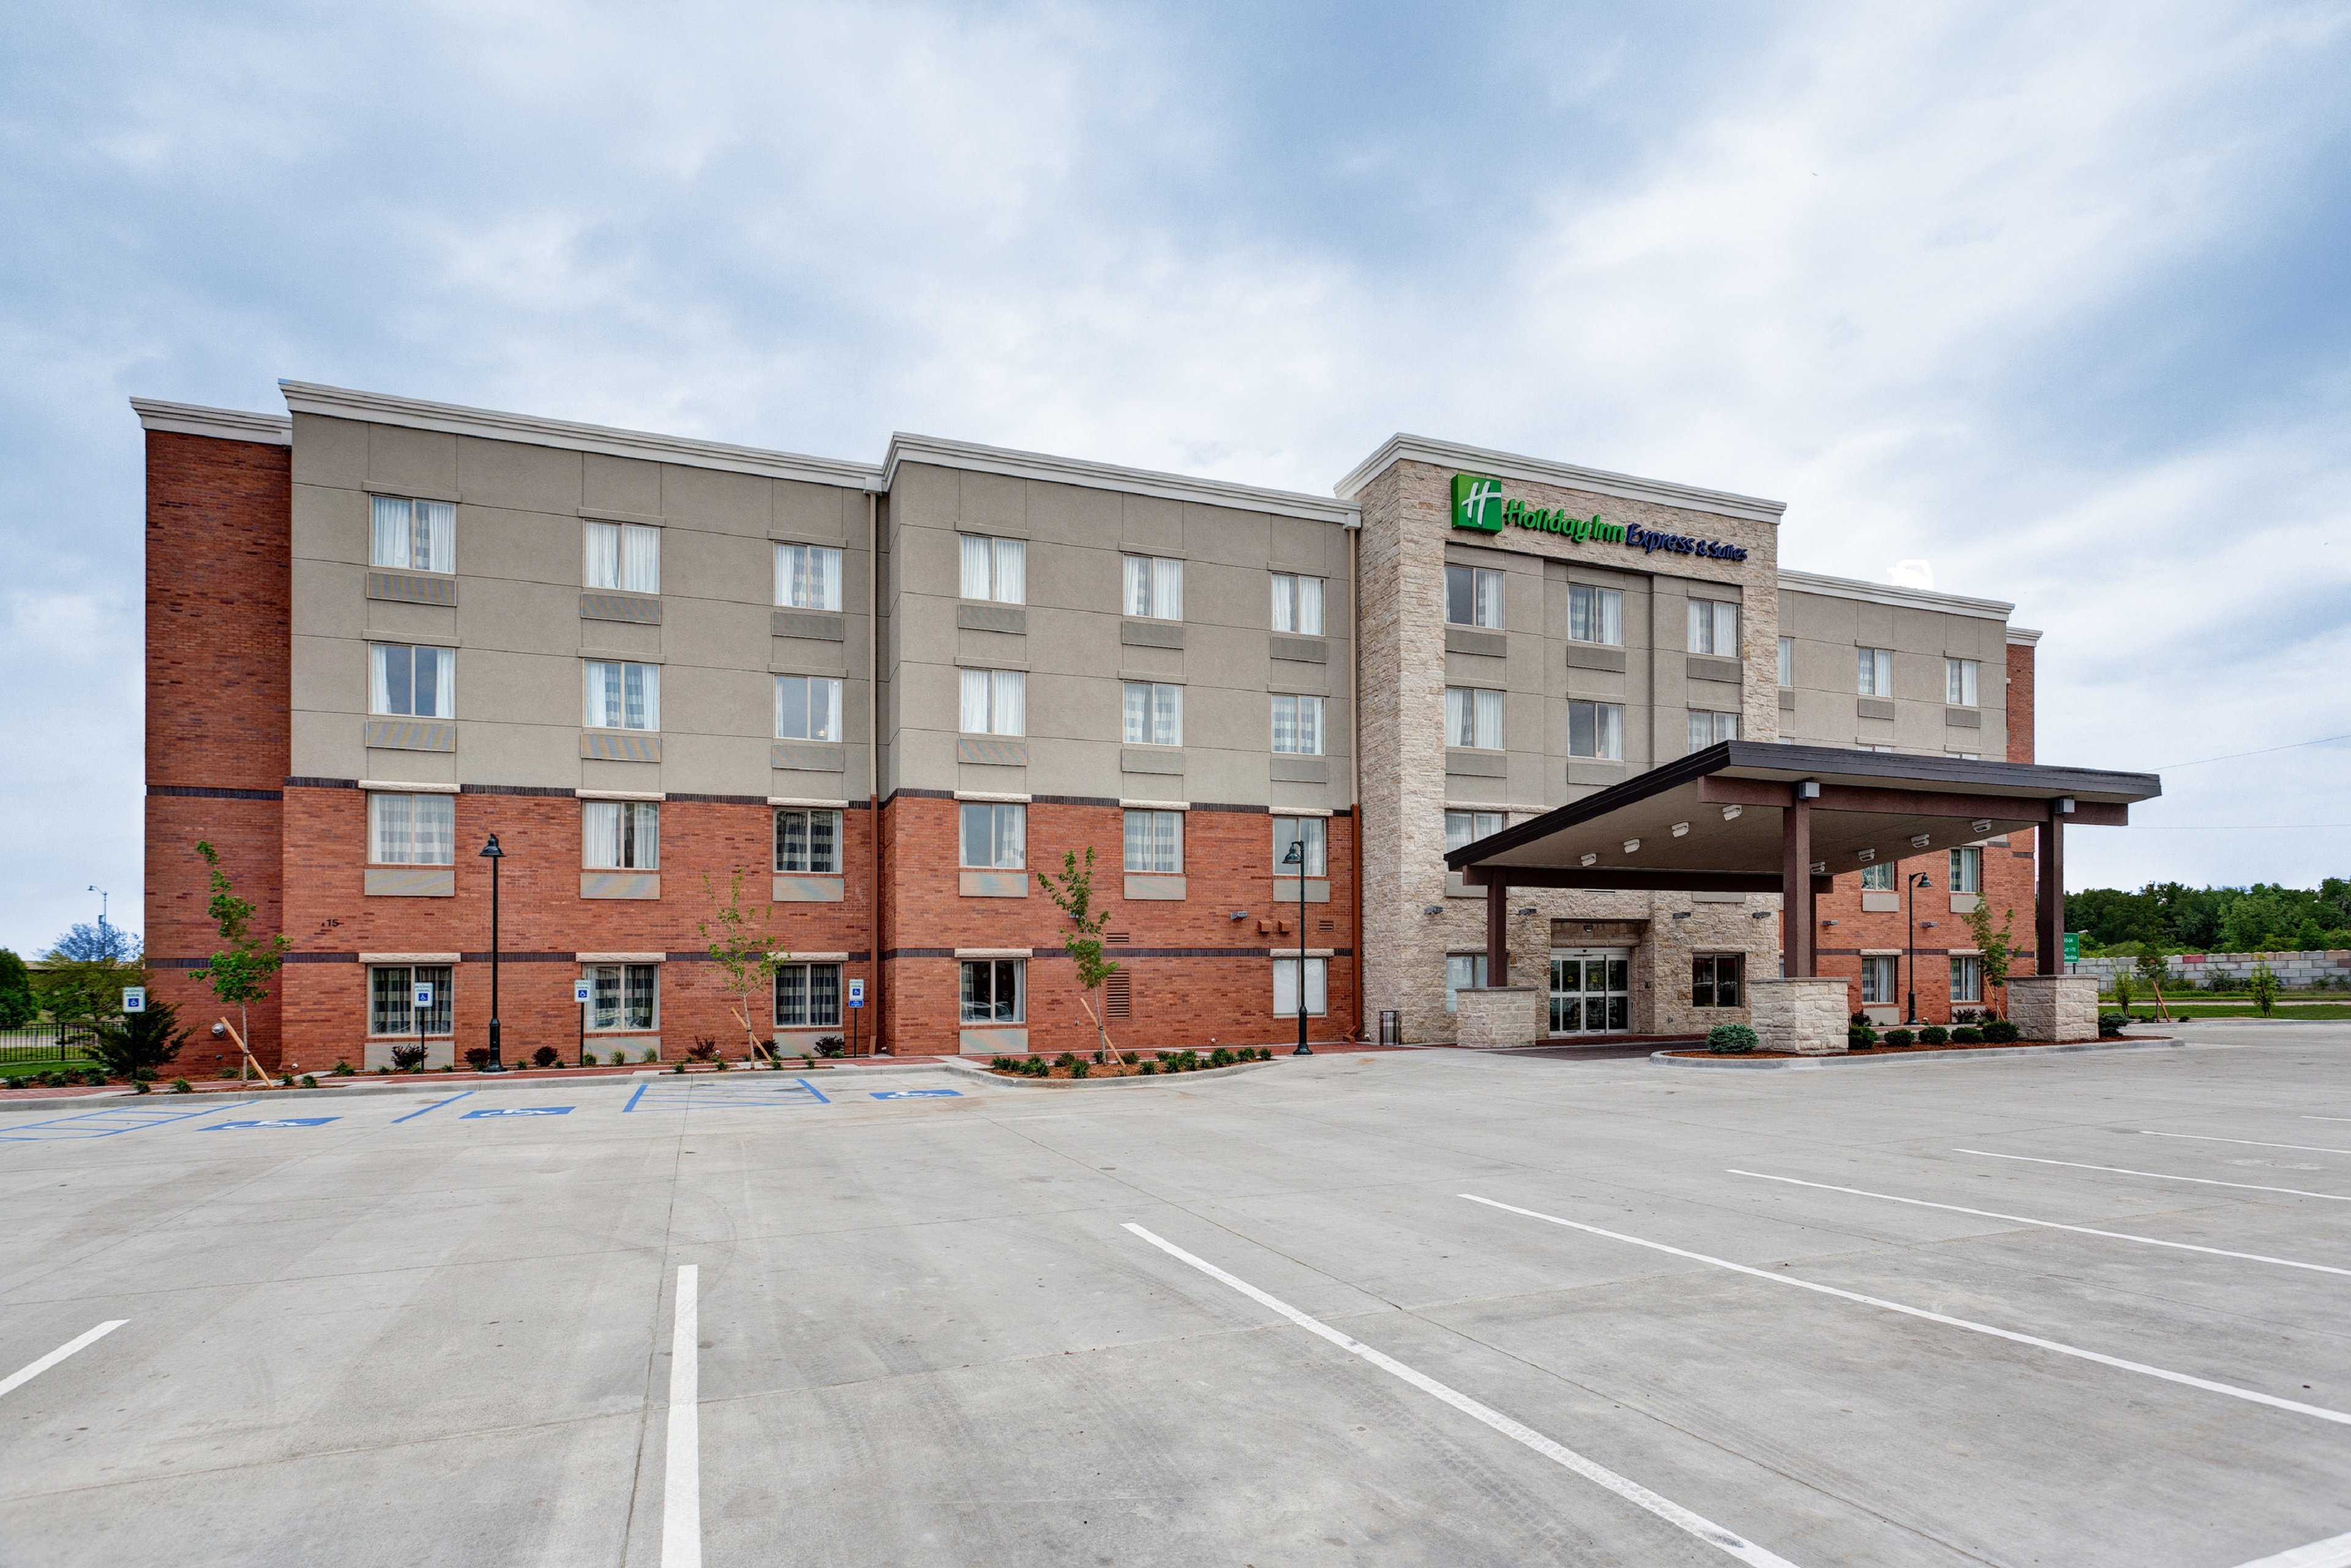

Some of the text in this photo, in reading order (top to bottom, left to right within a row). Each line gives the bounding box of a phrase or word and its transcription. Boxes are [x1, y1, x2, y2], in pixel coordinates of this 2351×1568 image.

[1505, 499, 1748, 561] Holiday Inn Express & Suites
